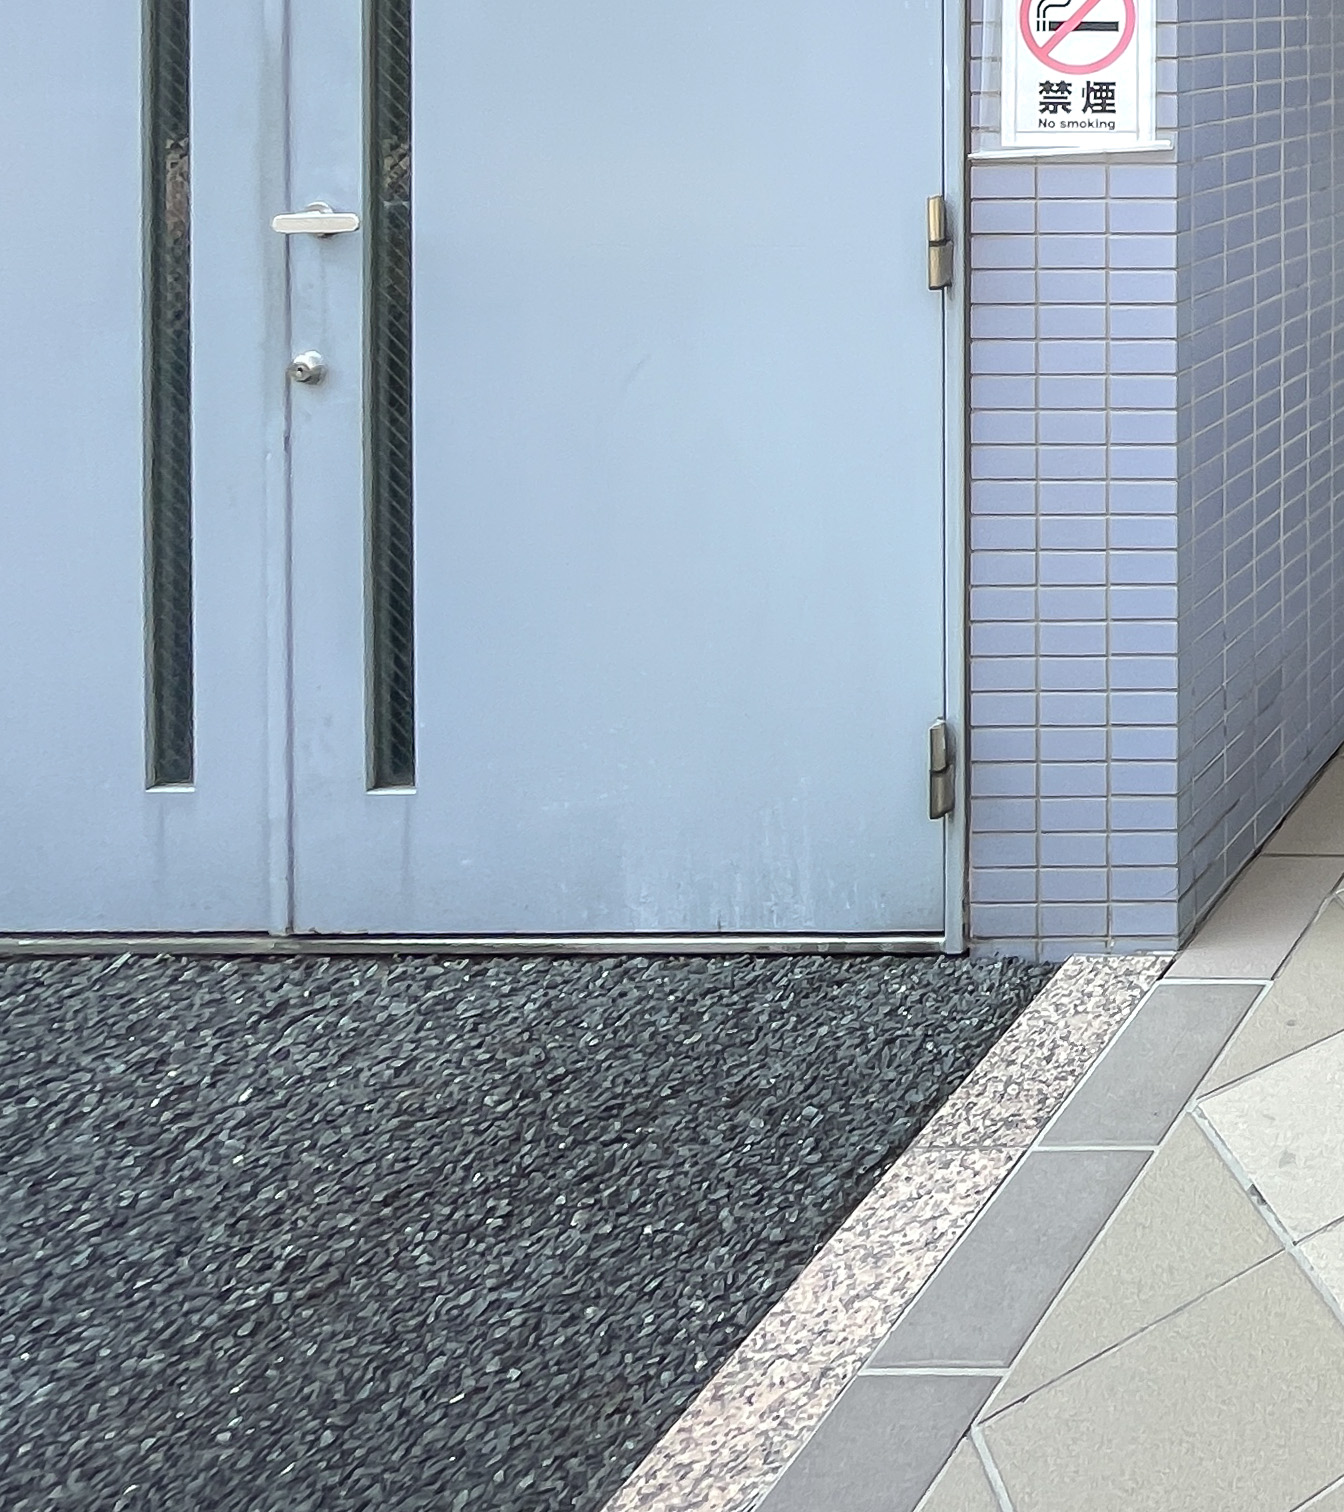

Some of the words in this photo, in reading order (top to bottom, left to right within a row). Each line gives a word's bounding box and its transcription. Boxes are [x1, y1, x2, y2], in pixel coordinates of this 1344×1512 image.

[1038, 80, 1117, 115] 禁煙
[1038, 118, 1056, 128] No
[1060, 118, 1116, 131] smoking
